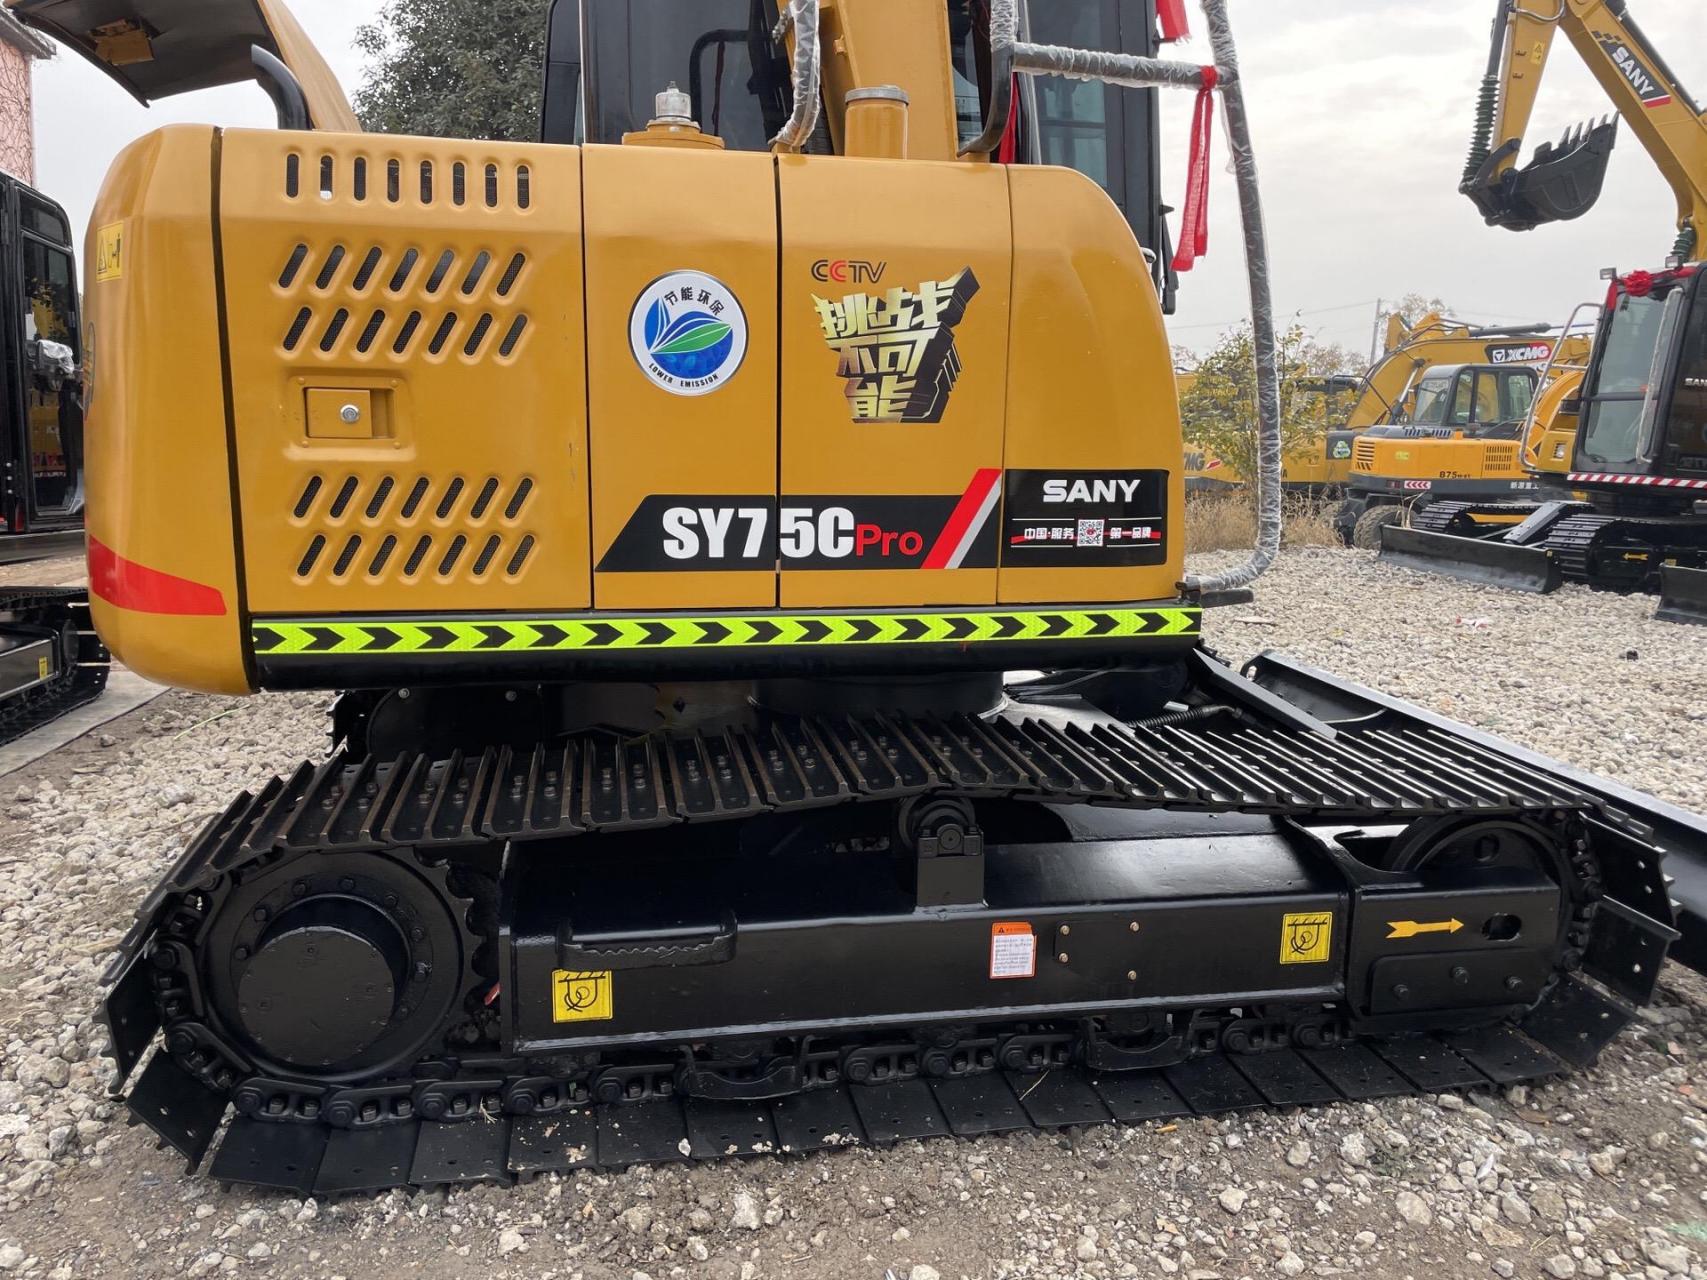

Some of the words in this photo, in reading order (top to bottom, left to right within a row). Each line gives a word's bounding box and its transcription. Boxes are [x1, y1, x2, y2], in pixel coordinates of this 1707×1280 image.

[1612, 46, 1654, 95] SANY
[811, 259, 887, 283] CCTV
[664, 286, 725, 316] 节能环保
[811, 266, 970, 338] 挑战
[825, 327, 941, 377] 不可
[1507, 345, 1550, 361] XCMG
[649, 363, 673, 384] LOWER
[680, 373, 719, 388] EMISSION
[844, 375, 918, 424] 能
[1043, 479, 1141, 503] SANY
